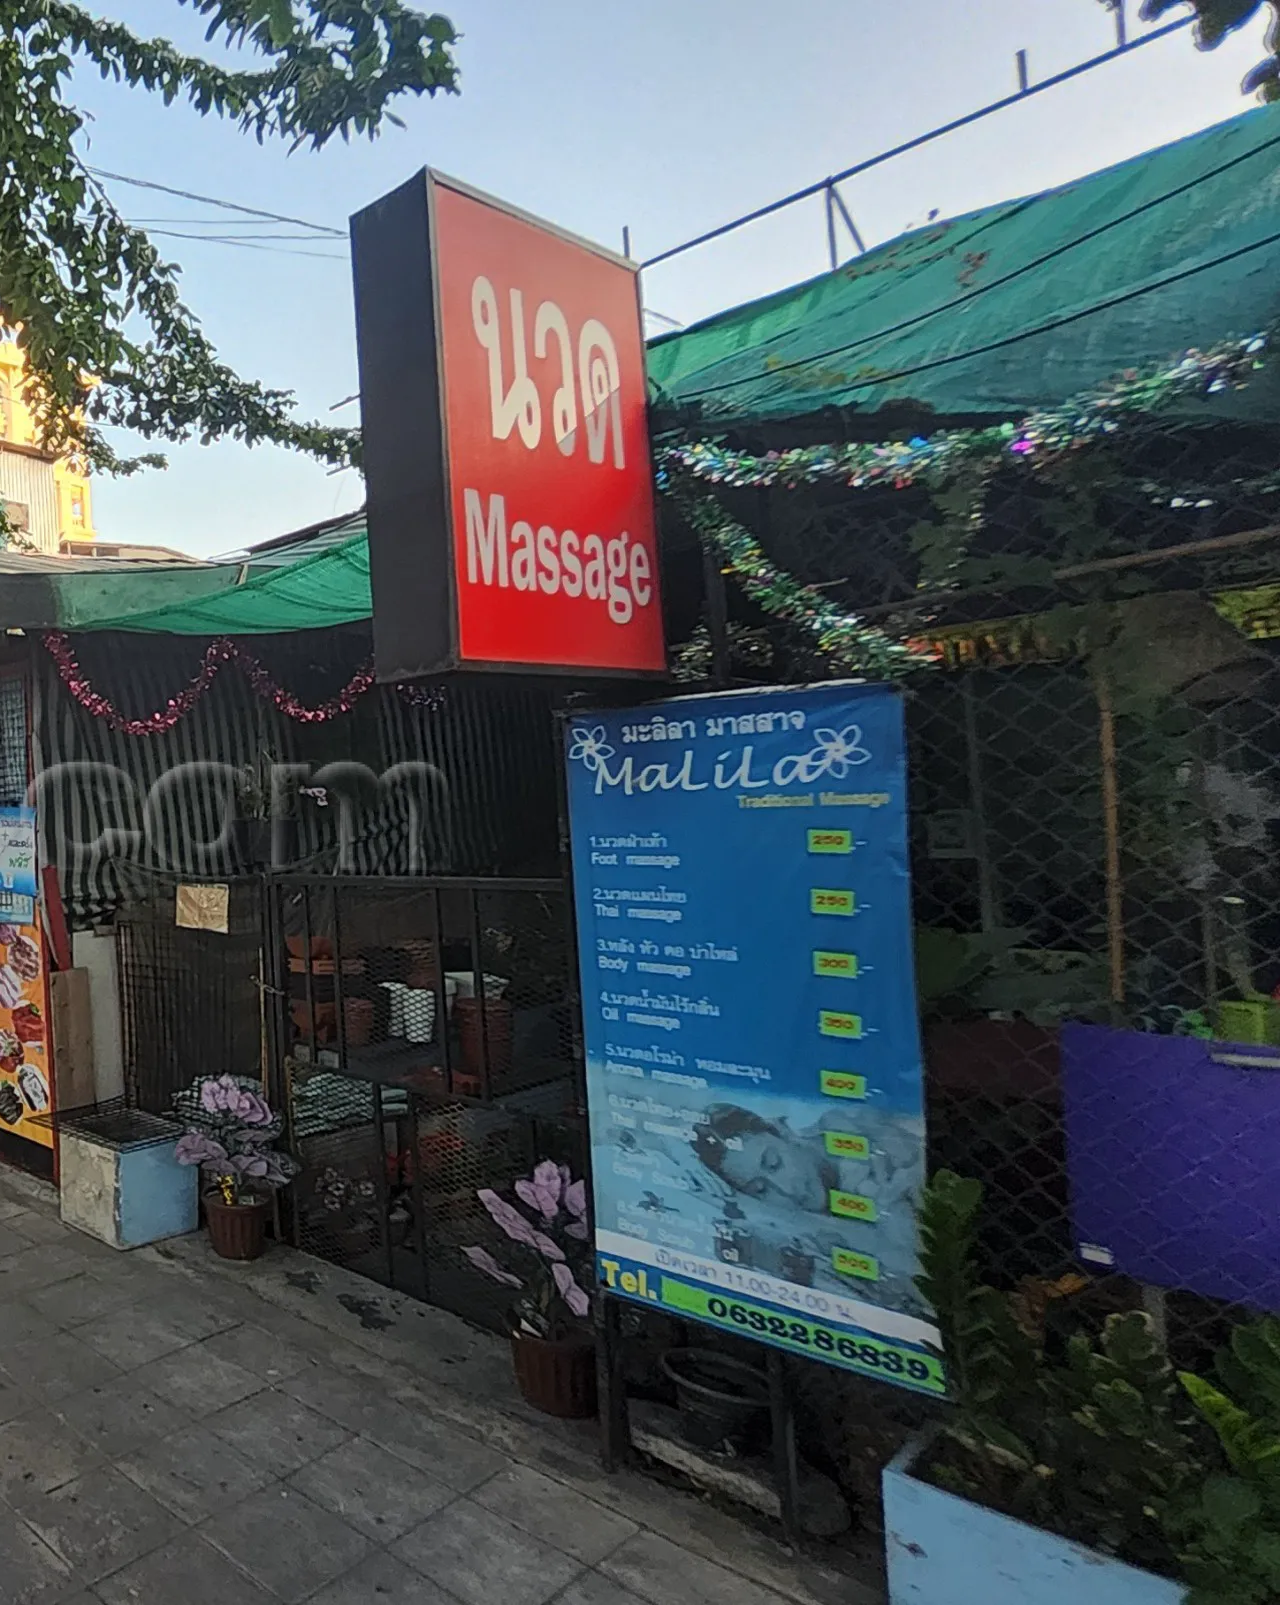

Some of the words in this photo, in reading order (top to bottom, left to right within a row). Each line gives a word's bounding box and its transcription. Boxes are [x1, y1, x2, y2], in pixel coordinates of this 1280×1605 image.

[471, 275, 625, 469] นวด
[463, 487, 651, 624] Massage
[621, 717, 696, 744] มะลิลา
[706, 710, 806, 738] มาสสาจ
[591, 852, 618, 865] Foot
[594, 903, 619, 917] Thai
[598, 955, 629, 973] Body
[601, 1007, 619, 1020] Oil
[600, 1259, 658, 1301] Tel.
[707, 1297, 930, 1381] 0632286839
